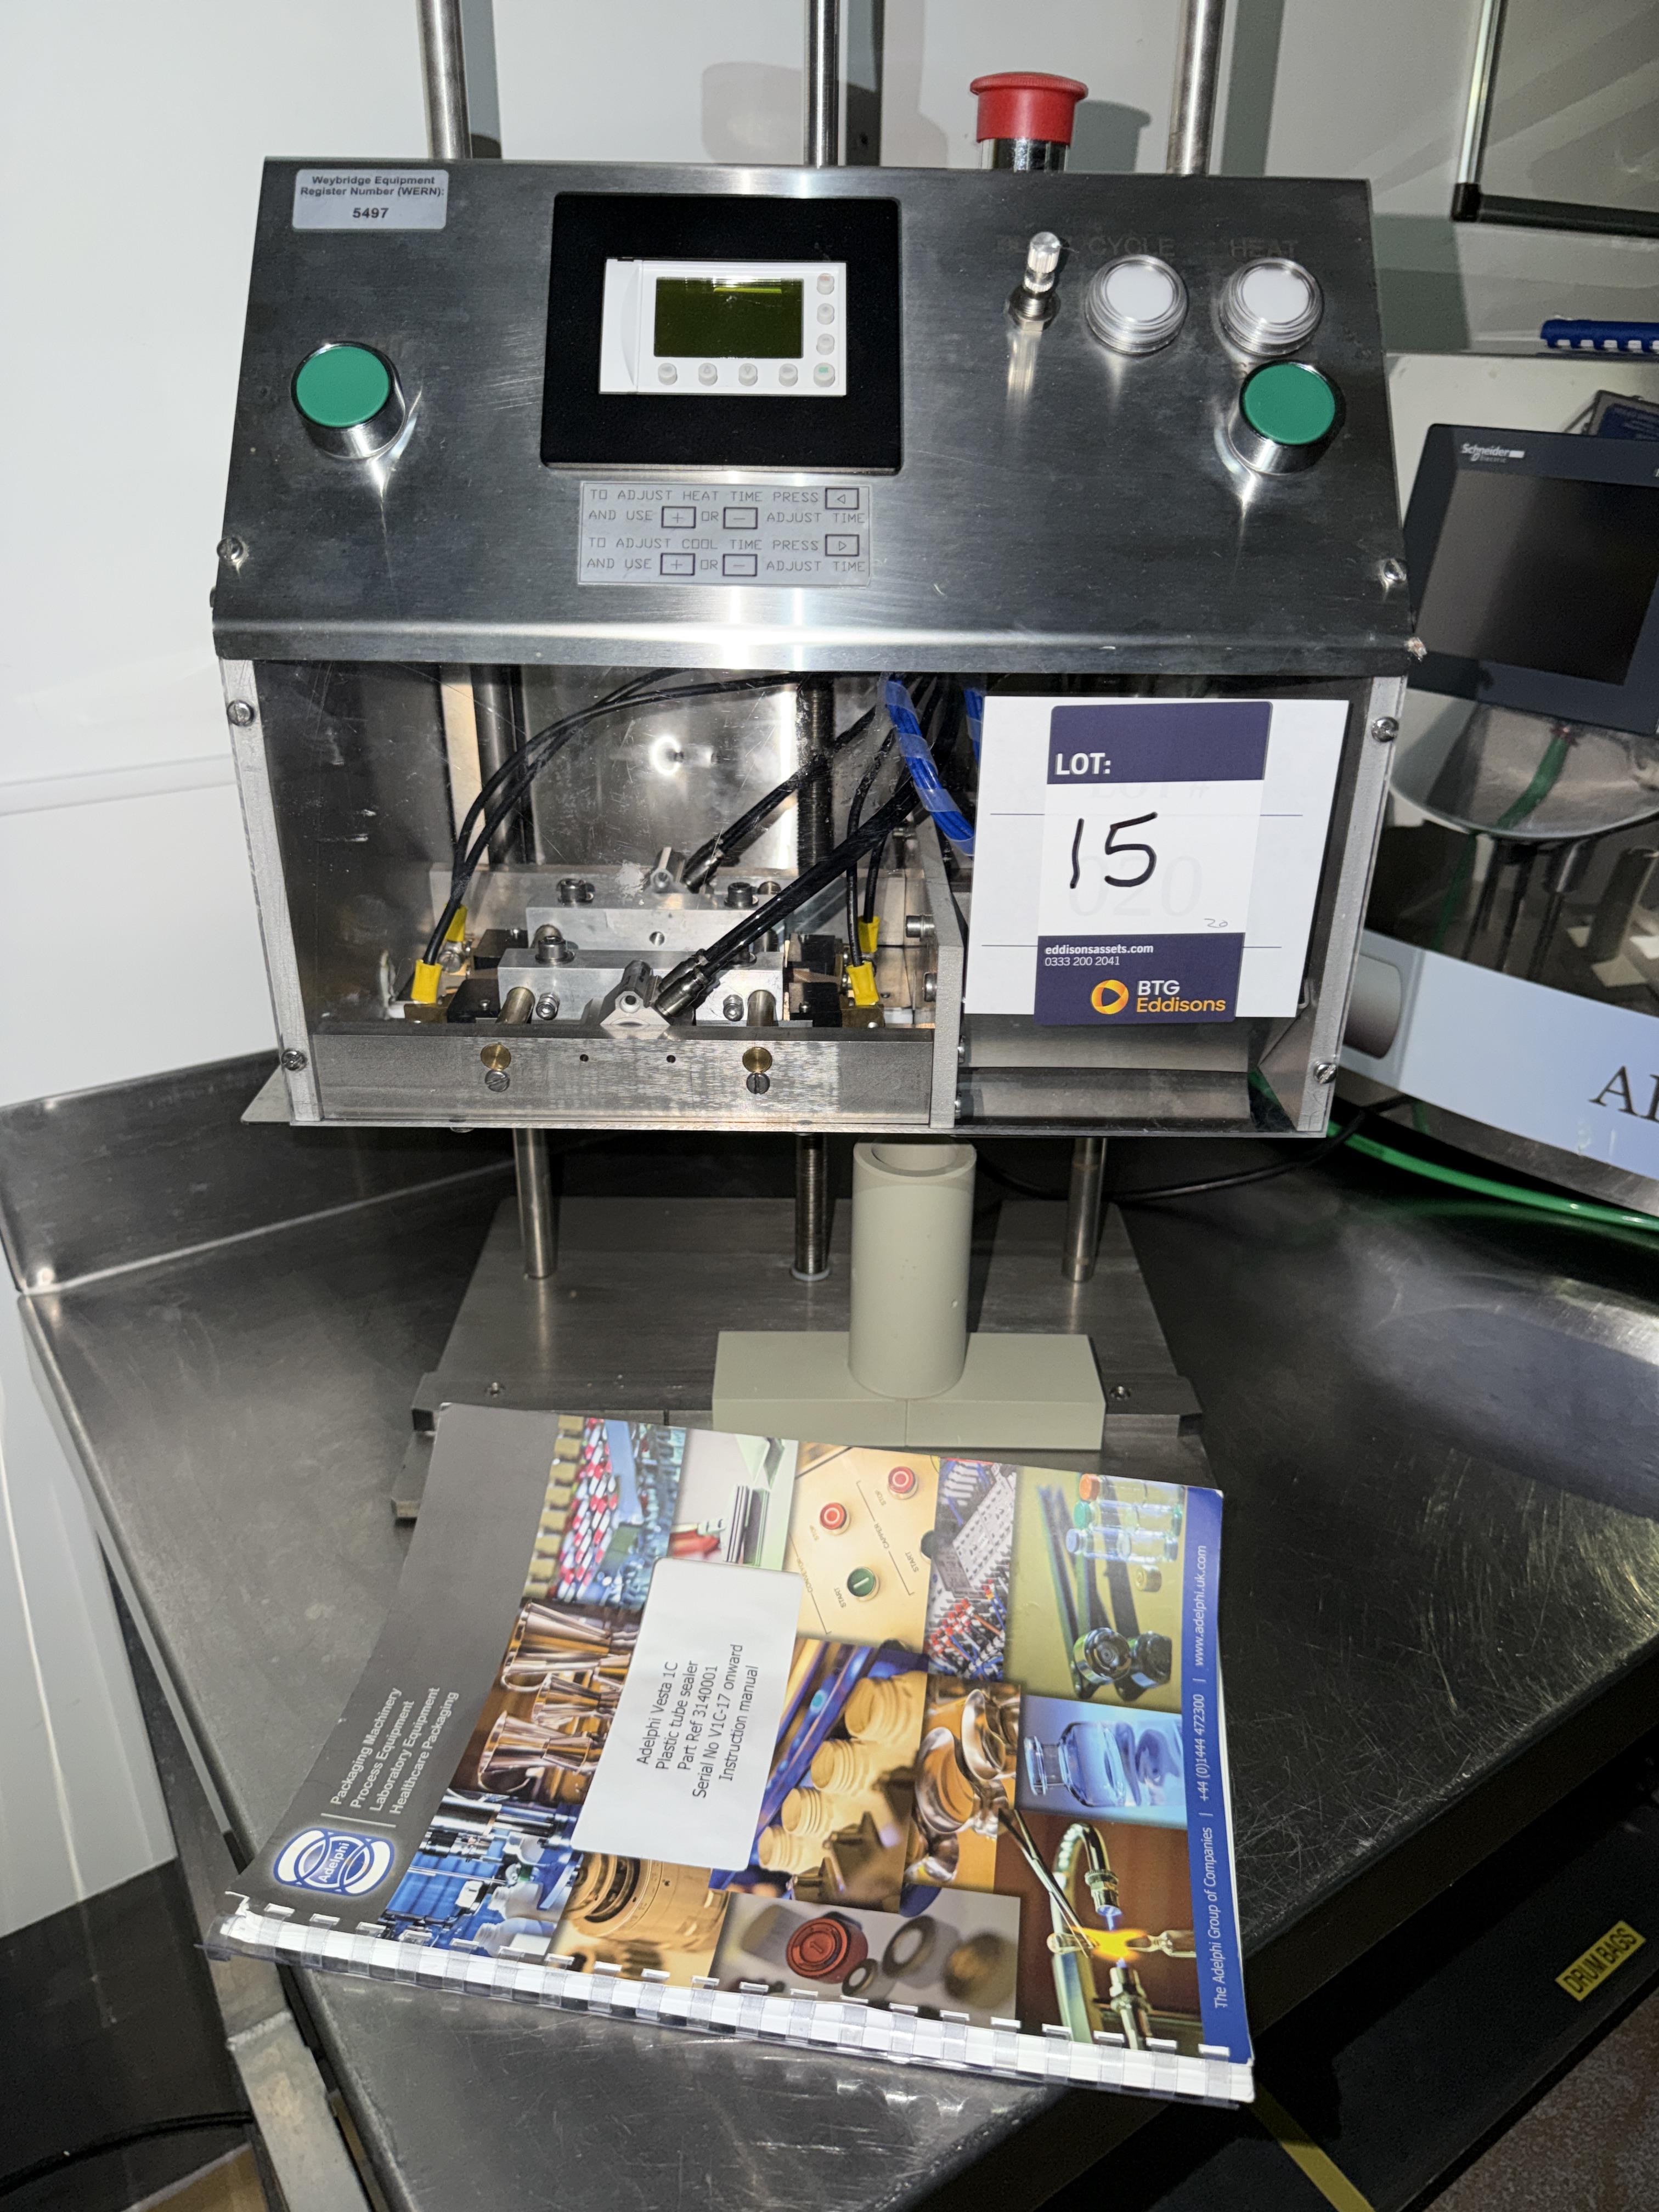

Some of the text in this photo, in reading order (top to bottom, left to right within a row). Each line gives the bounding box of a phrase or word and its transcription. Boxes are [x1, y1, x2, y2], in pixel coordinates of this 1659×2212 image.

[301, 187, 444, 196] Register Number (WERN):
[312, 176, 435, 186] Weybridge Equipment
[352, 207, 389, 219] 5497
[1088, 236, 1299, 257] CYCLE HEAT
[1462, 443, 1509, 456] Schneider
[590, 489, 819, 503] TO ADJUST HEAT TIME PRESS
[588, 510, 617, 521] AND
[626, 510, 653, 521] USE
[701, 511, 720, 522] OR
[766, 512, 822, 523] ADJUST
[833, 513, 866, 524] TIME
[589, 538, 819, 551] TO ADJUST COOL TIME PRESS
[586, 558, 615, 569] AND
[624, 559, 652, 570] USE
[700, 560, 719, 571] OR
[766, 561, 822, 572] ADJUST
[833, 561, 866, 573] TIME
[1055, 752, 1111, 775] LOT:
[1069, 811, 1158, 889] 15
[1203, 918, 1228, 929] 20
[1045, 943, 1154, 955] eddisonsassets.com
[1045, 956, 1120, 967] 0333 200 2041
[1137, 980, 1180, 996] BTG
[1136, 997, 1227, 1013] Eddisons
[874, 1522, 890, 1549] CAPPER
[905, 1551, 919, 1572] START
[797, 1558, 813, 1593] CONVEYOR
[834, 1587, 847, 1608] START
[636, 1661, 678, 1764] Adelphi Vesta 1C
[656, 1660, 698, 1770] Plastic tube sealer
[677, 1666, 718, 1770] Part Ref 3140001
[692, 1644, 743, 1798] Serial No V1C-17 onward
[719, 1665, 759, 1781] Instruction manual
[330, 1687, 402, 1805] Packaging Machinery
[350, 1700, 415, 1809] Process Equipment
[369, 1687, 440, 1812] Laboratory Equipment
[390, 1691, 460, 1815] Healthcare Packaging
[1193, 1545, 1228, 2009] The Adelphi Group of Companies +44 (0)1444 472300 www.adelphi.uk.com
[318, 1842, 350, 1883] Adelphi
[1563, 1927, 1637, 1994] DRUM BAGS
